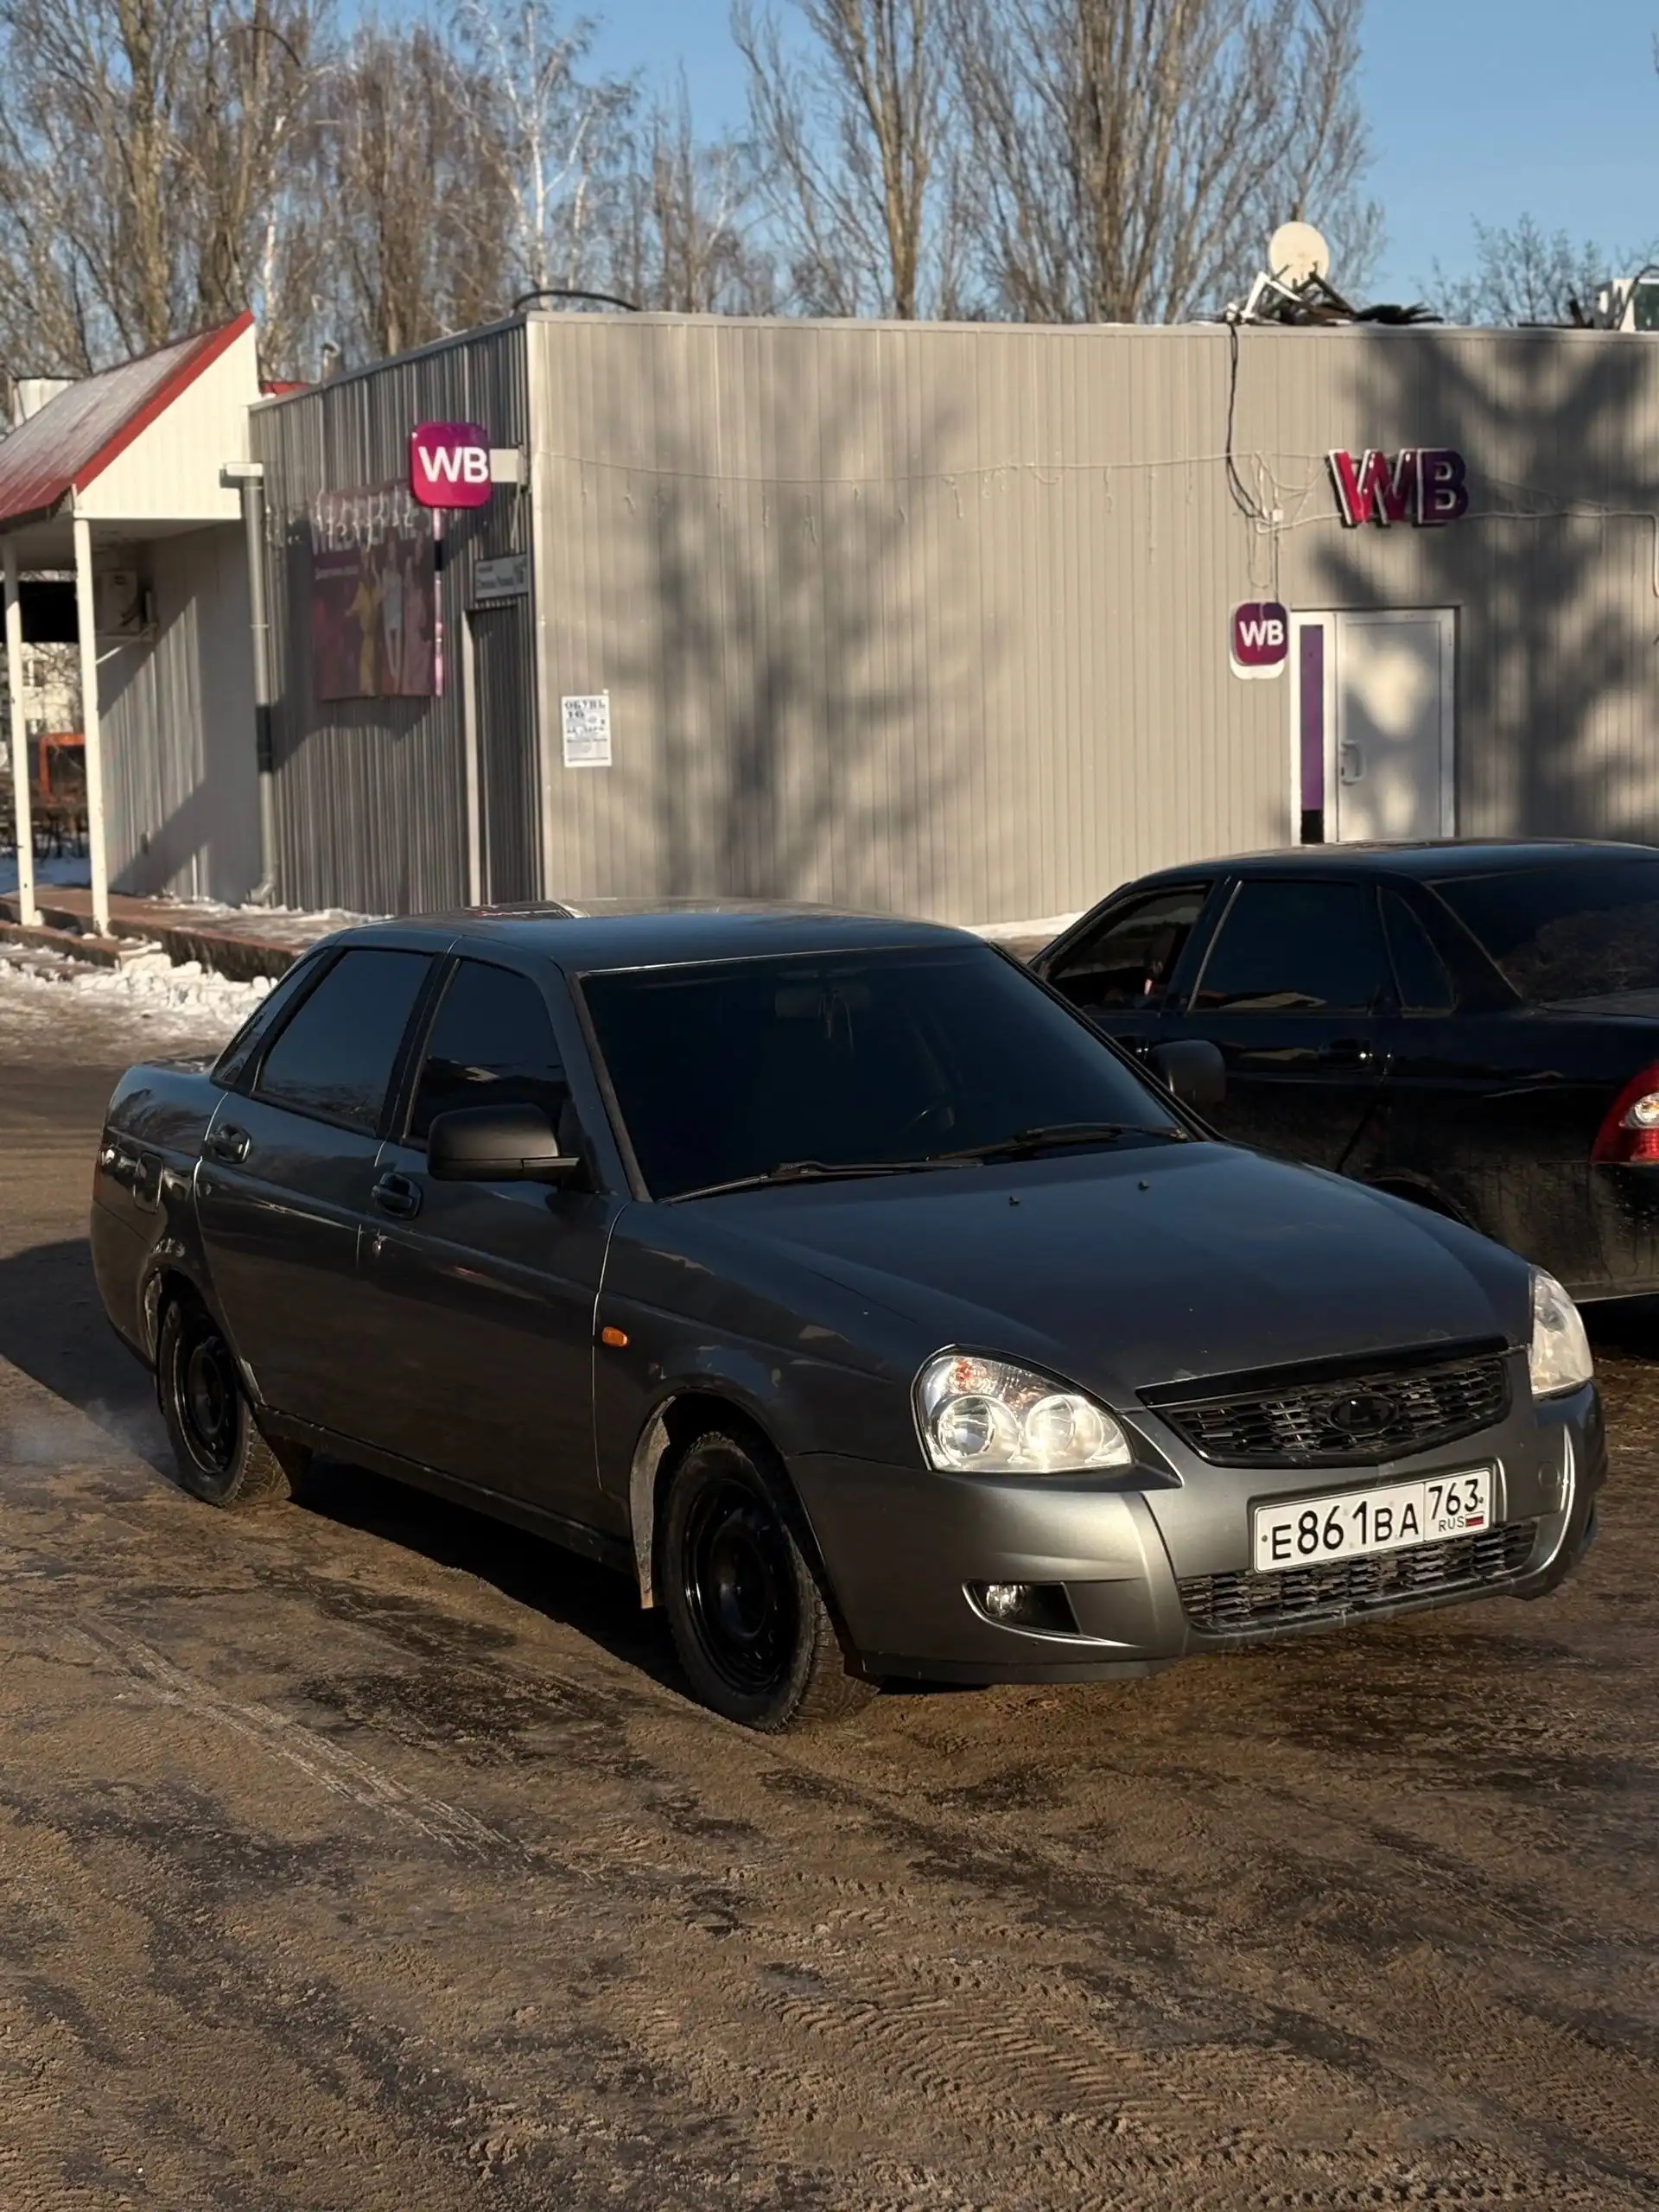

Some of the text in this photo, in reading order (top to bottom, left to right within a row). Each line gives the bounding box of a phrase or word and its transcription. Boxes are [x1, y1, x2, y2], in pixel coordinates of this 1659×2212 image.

[418, 446, 488, 483] WB
[1328, 448, 1468, 524] WB
[1239, 620, 1284, 647] WB
[1272, 1478, 1479, 1560] Е861ВА 763
[1438, 1516, 1465, 1532] RUS
